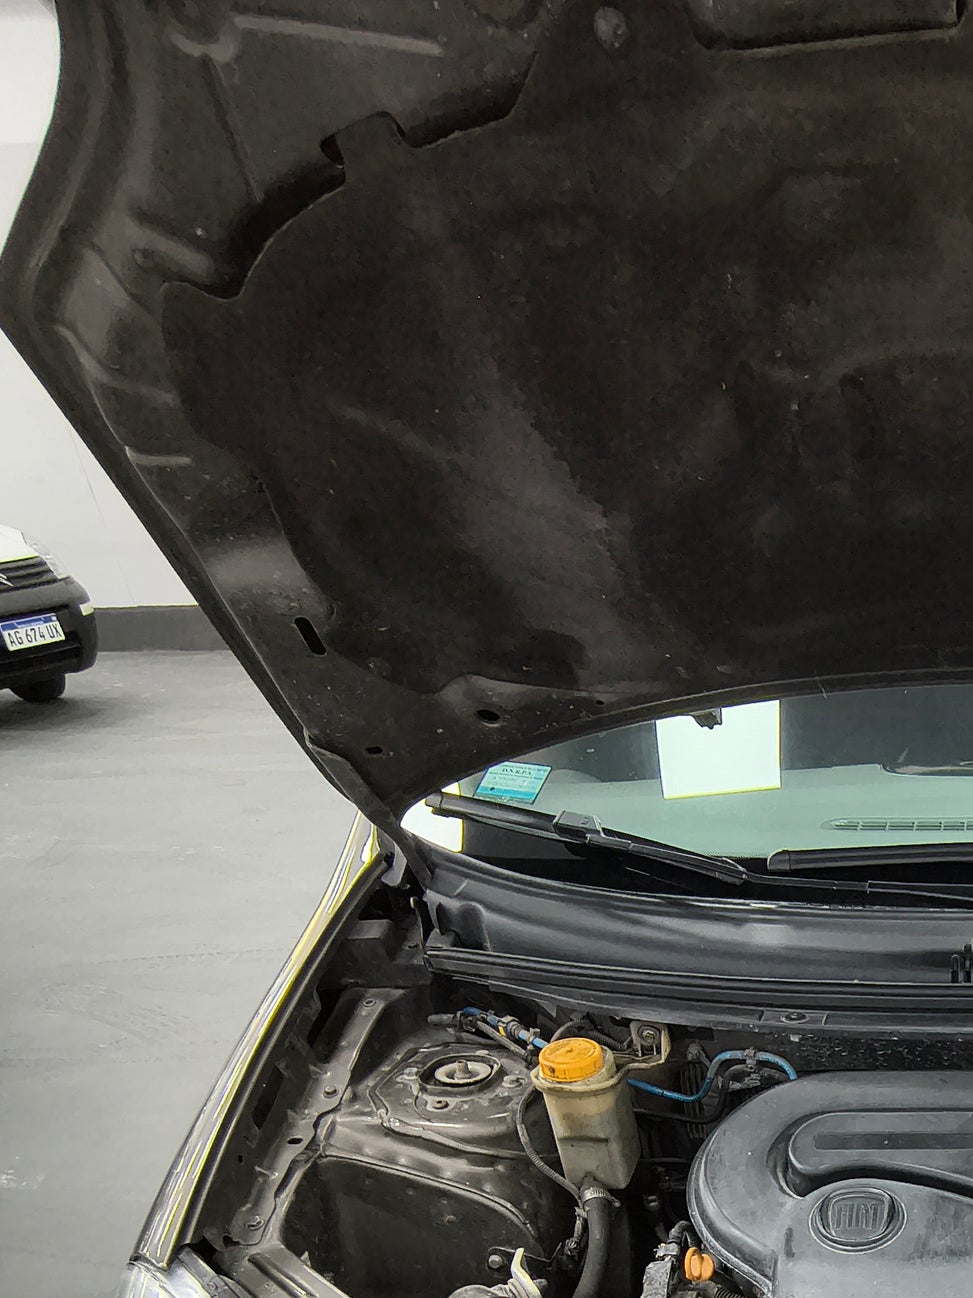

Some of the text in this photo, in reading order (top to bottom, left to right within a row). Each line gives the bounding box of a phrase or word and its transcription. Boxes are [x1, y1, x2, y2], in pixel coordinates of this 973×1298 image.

[8, 630, 24, 647] AG
[25, 627, 46, 643] 674
[834, 1202, 885, 1230] FIAT
